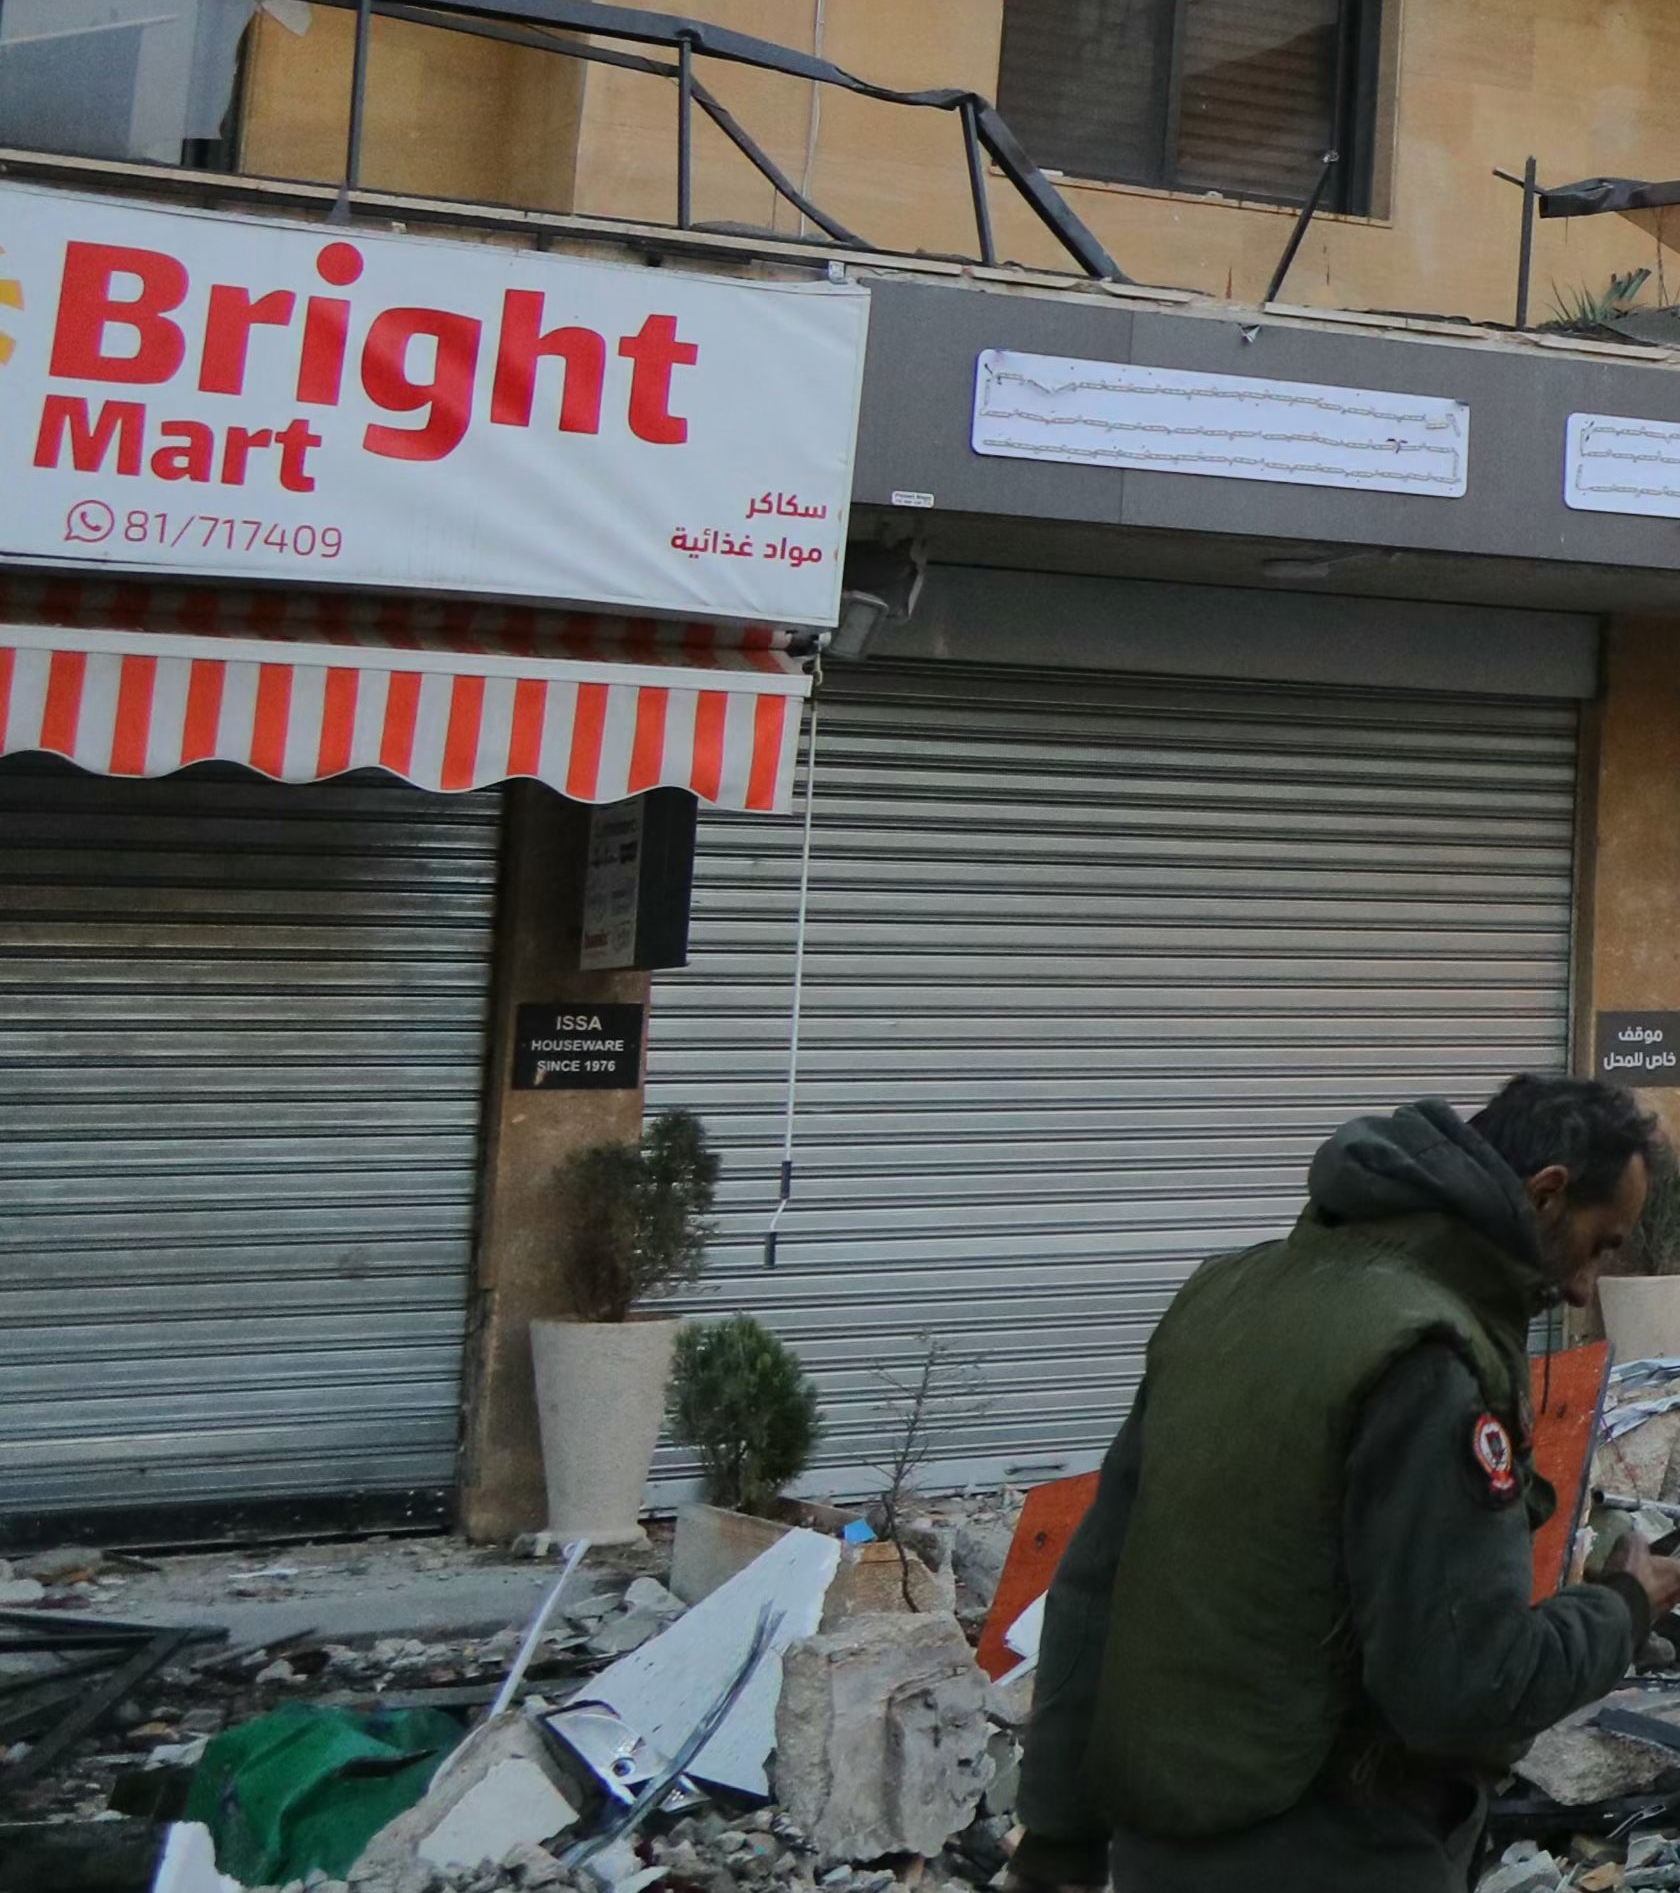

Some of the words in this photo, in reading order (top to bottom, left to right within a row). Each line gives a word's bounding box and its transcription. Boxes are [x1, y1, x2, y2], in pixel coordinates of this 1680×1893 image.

[48, 240, 698, 461] Bright
[33, 393, 322, 493] Mart
[745, 491, 827, 520] سكاكر
[124, 508, 343, 559] 81/717409
[671, 527, 753, 560] غذائية
[763, 537, 822, 568] مواد
[556, 1015, 602, 1031] ISSA
[531, 1039, 624, 1052] HOUSEWARE
[1618, 1026, 1663, 1045] موقف
[536, 1059, 581, 1072] SINCE
[584, 1059, 616, 1072] 1976
[1603, 1051, 1643, 1071] للمحل
[1645, 1051, 1676, 1070] خاص
